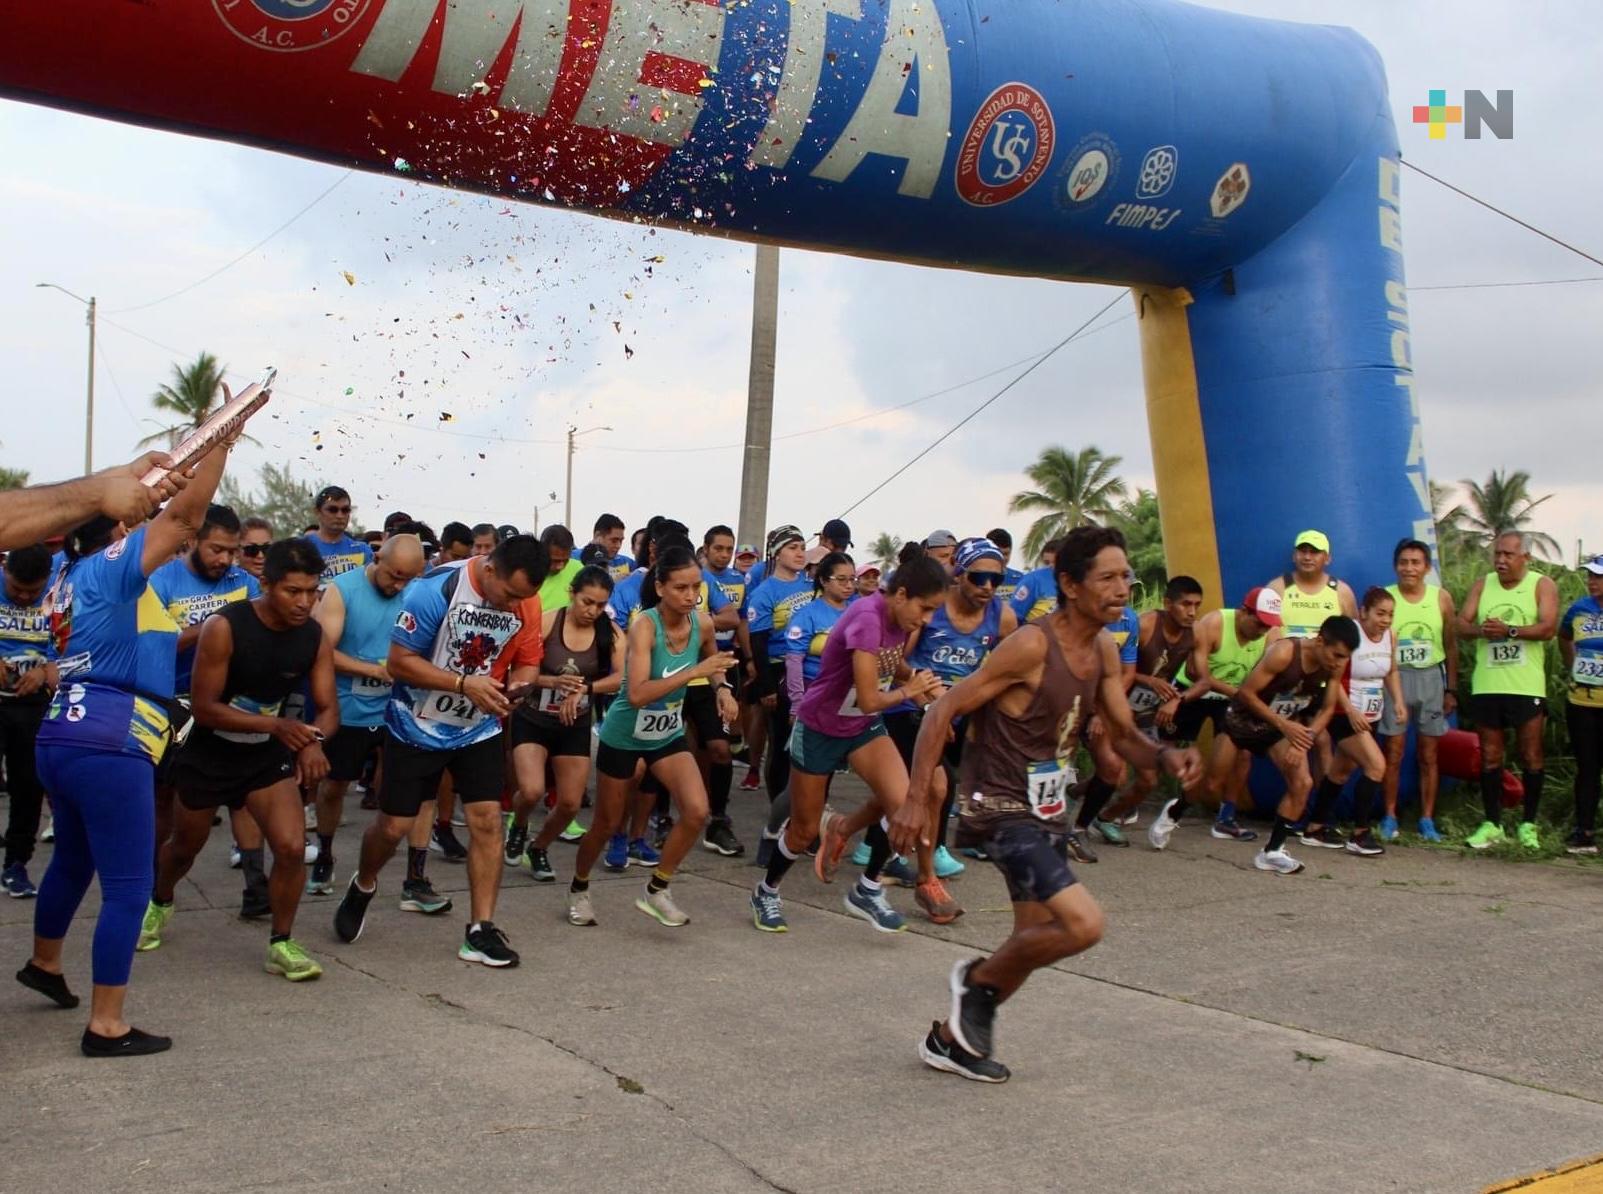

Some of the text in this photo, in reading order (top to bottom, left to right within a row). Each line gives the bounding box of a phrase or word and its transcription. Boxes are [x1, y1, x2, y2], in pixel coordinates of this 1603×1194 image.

[350, 0, 952, 198] META
[961, 92, 1014, 176] UNIVERSIDAD
[1016, 91, 1031, 107] DE
[1024, 102, 1050, 183] SOTAVENTO
[1105, 203, 1182, 230] FIMPES
[1493, 645, 1520, 660] 132
[641, 711, 678, 732] 202
